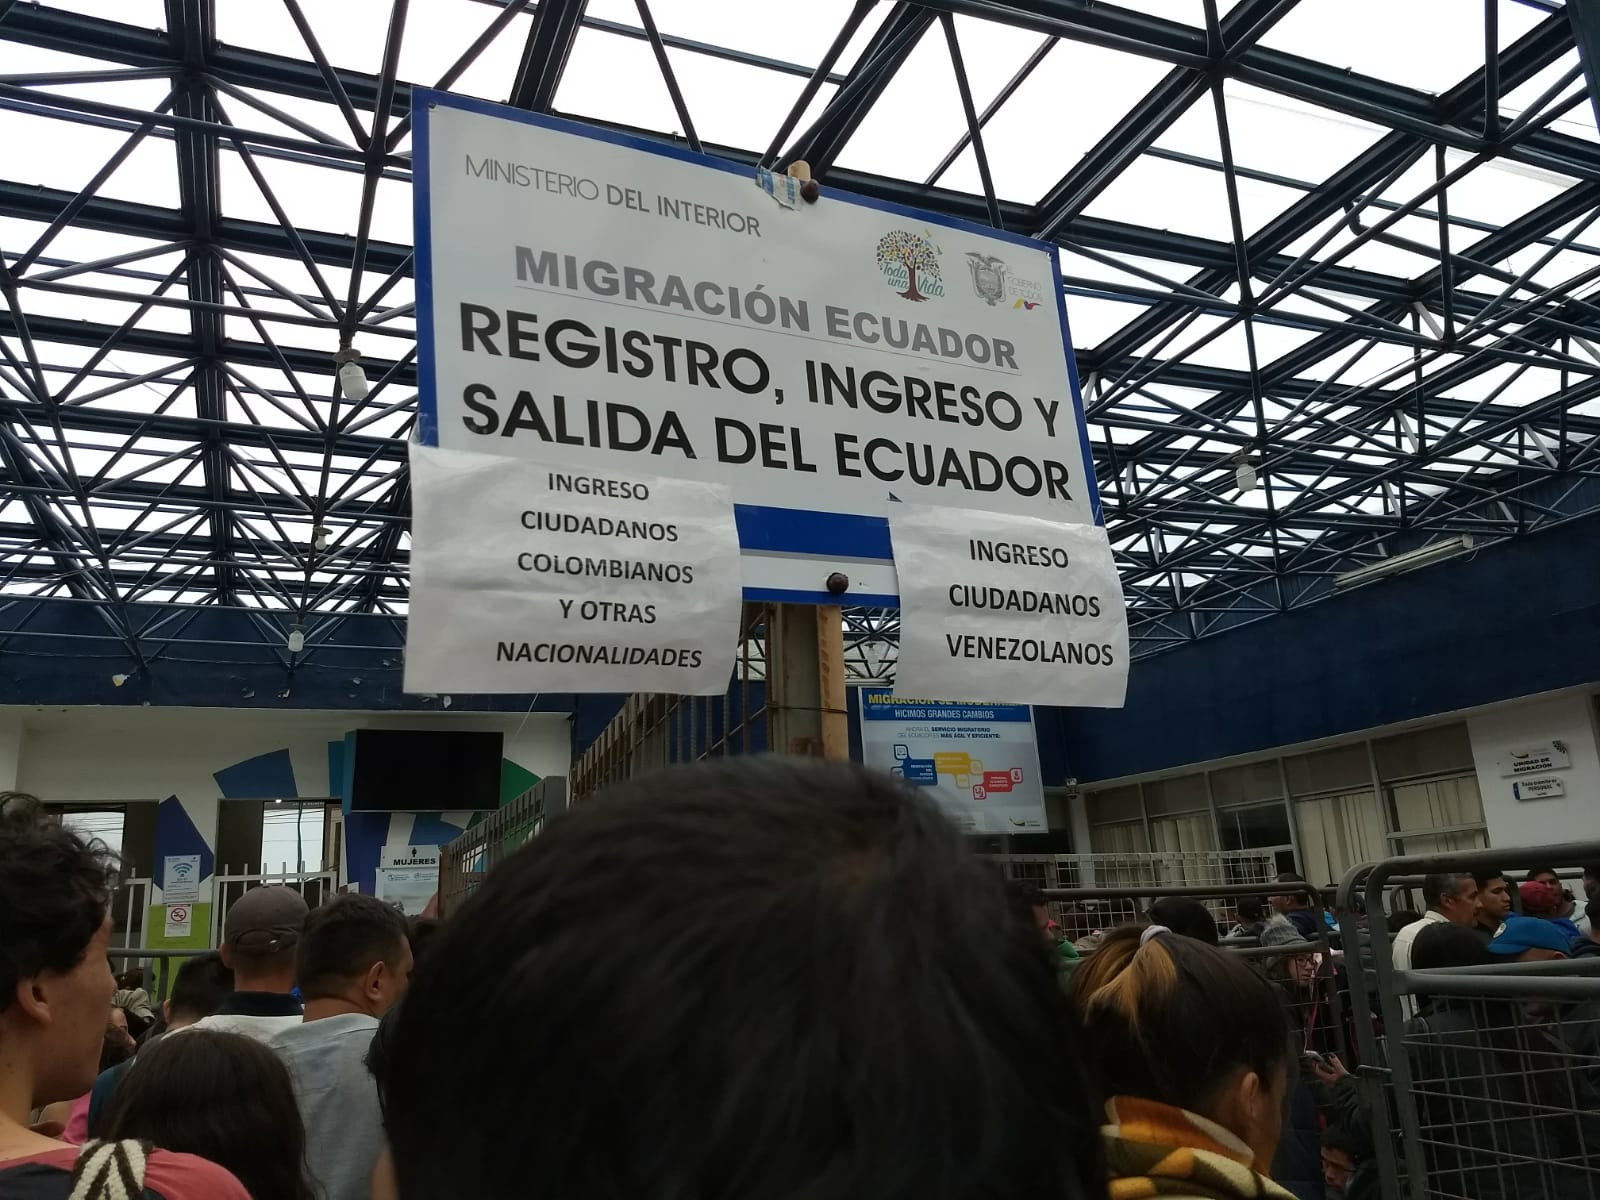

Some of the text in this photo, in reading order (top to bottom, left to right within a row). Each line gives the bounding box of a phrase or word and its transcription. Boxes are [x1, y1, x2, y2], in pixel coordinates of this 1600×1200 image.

[465, 153, 762, 238] MINISTERIO DEL INTERIOR
[883, 261, 909, 280] Toda
[887, 274, 945, 298] una Vida
[514, 245, 1020, 371] MIGRACIÓN ECUADOR
[459, 301, 1060, 438] REGISTRO, INGRESO Y
[462, 382, 1074, 502] SALIDA DEL ECUADOR
[548, 472, 650, 501] INGRESO
[520, 510, 679, 542] CIUDADANOS
[517, 552, 694, 585] COLOMBIANOS
[969, 539, 1069, 569] INGRESO
[558, 599, 657, 624] Y OTRAS
[948, 583, 1101, 618] CIUDADANOS
[496, 641, 703, 669] NACIONALIDADES
[945, 633, 1114, 667] VENEZOLANOS
[895, 708, 995, 720] HICIMOS GRANDES CAMBIOS
[1513, 759, 1540, 767] UNIDAD
[392, 857, 437, 867] MUJERES
